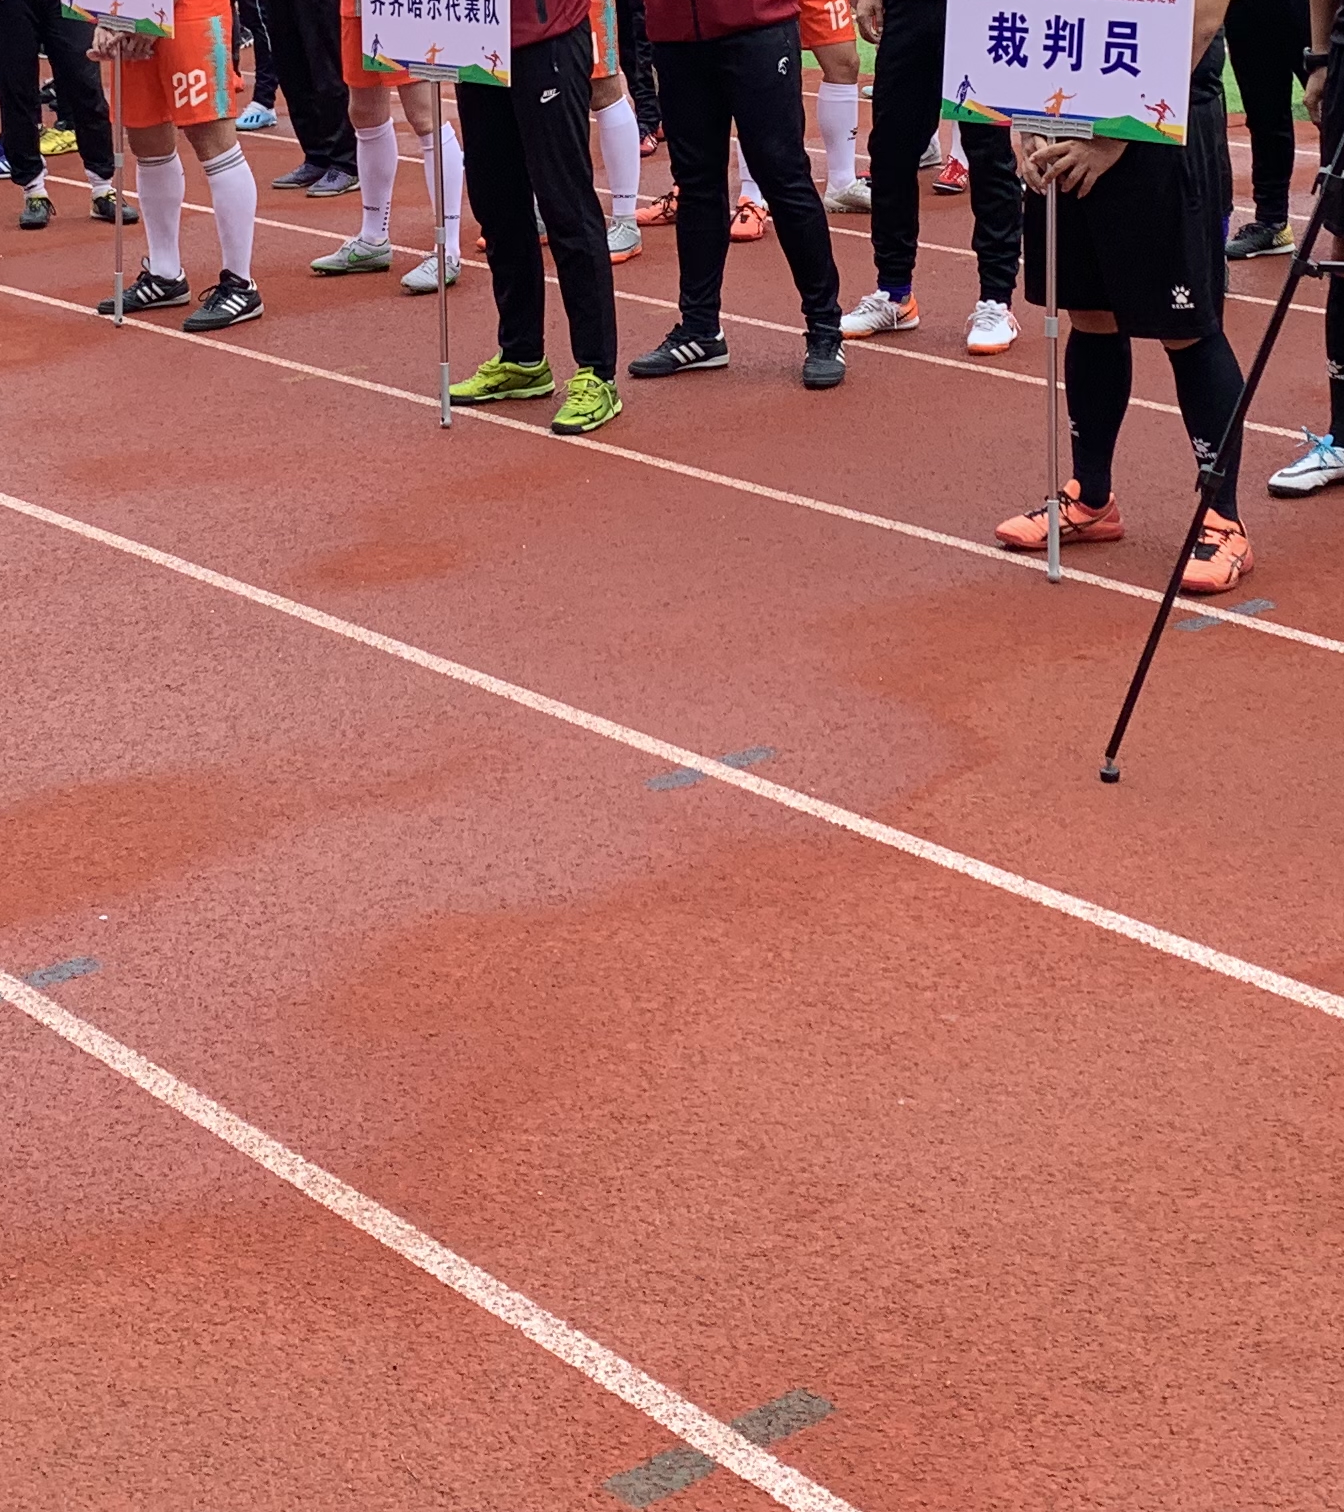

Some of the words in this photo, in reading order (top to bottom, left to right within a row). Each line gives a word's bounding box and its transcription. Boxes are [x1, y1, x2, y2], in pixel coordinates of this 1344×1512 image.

[987, 11, 1142, 77] 裁判员
[172, 68, 208, 109] 22
